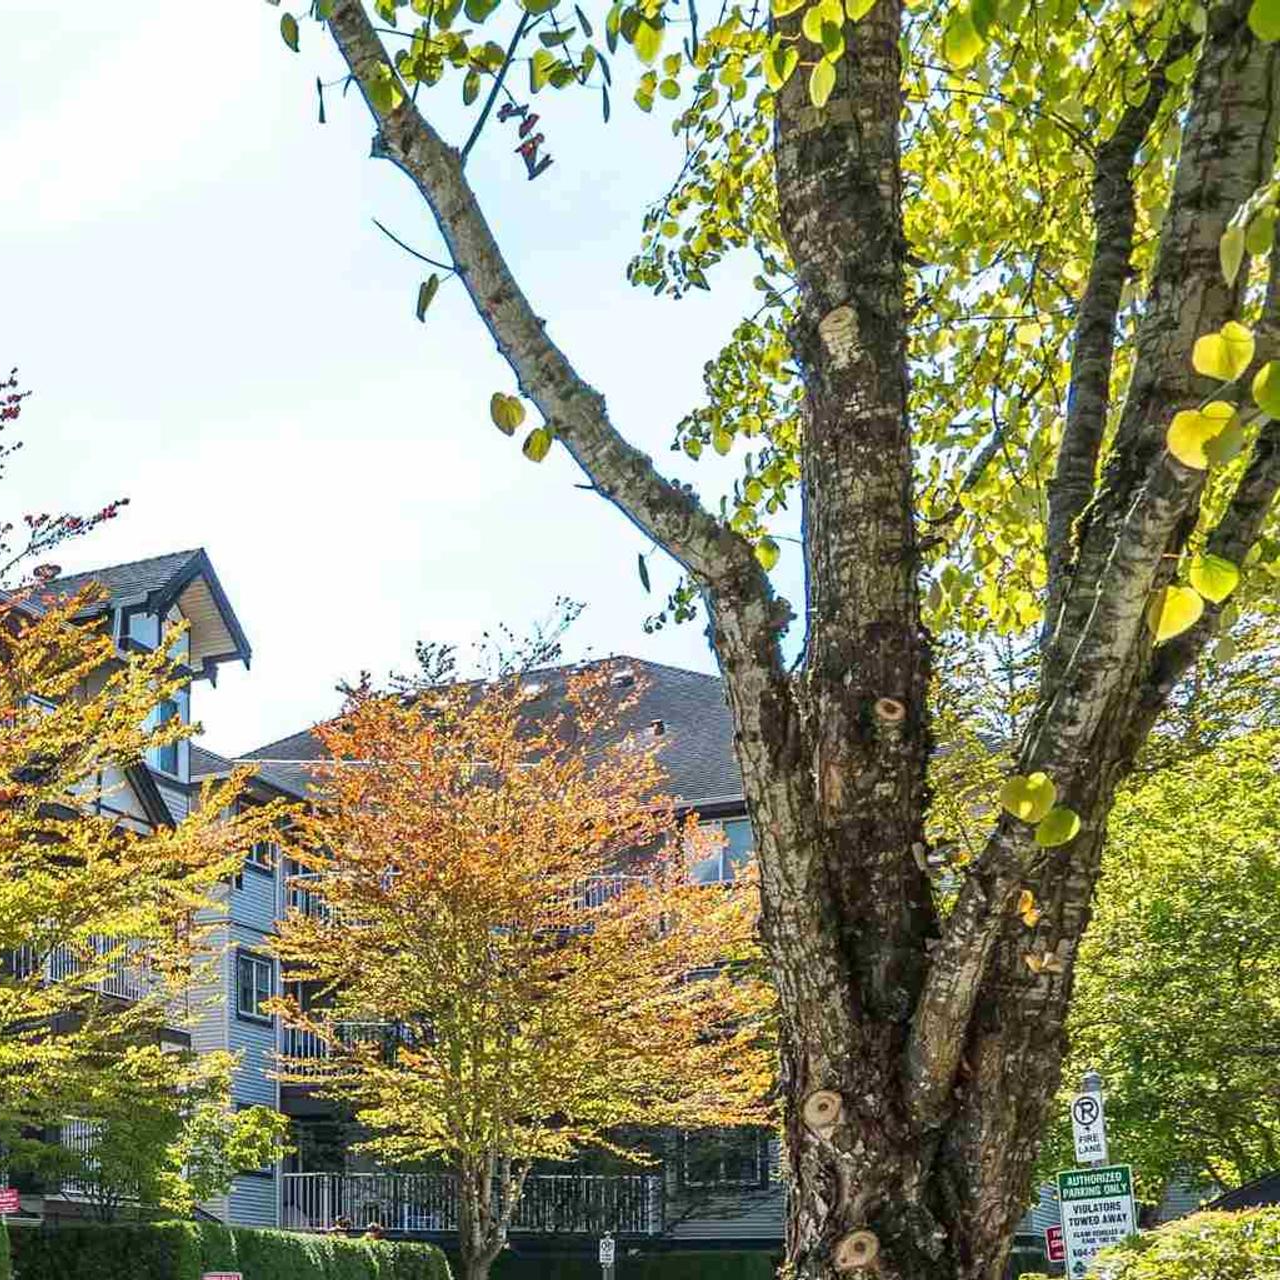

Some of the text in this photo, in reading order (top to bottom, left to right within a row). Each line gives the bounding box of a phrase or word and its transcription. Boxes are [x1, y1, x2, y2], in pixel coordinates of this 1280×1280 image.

[1067, 1171, 1122, 1186] AUTHORIZED
[1063, 1183, 1128, 1199] PARKING ONLY
[1073, 1201, 1122, 1214] VIOLATORS
[1069, 1213, 1128, 1227] TOWED AWAY
